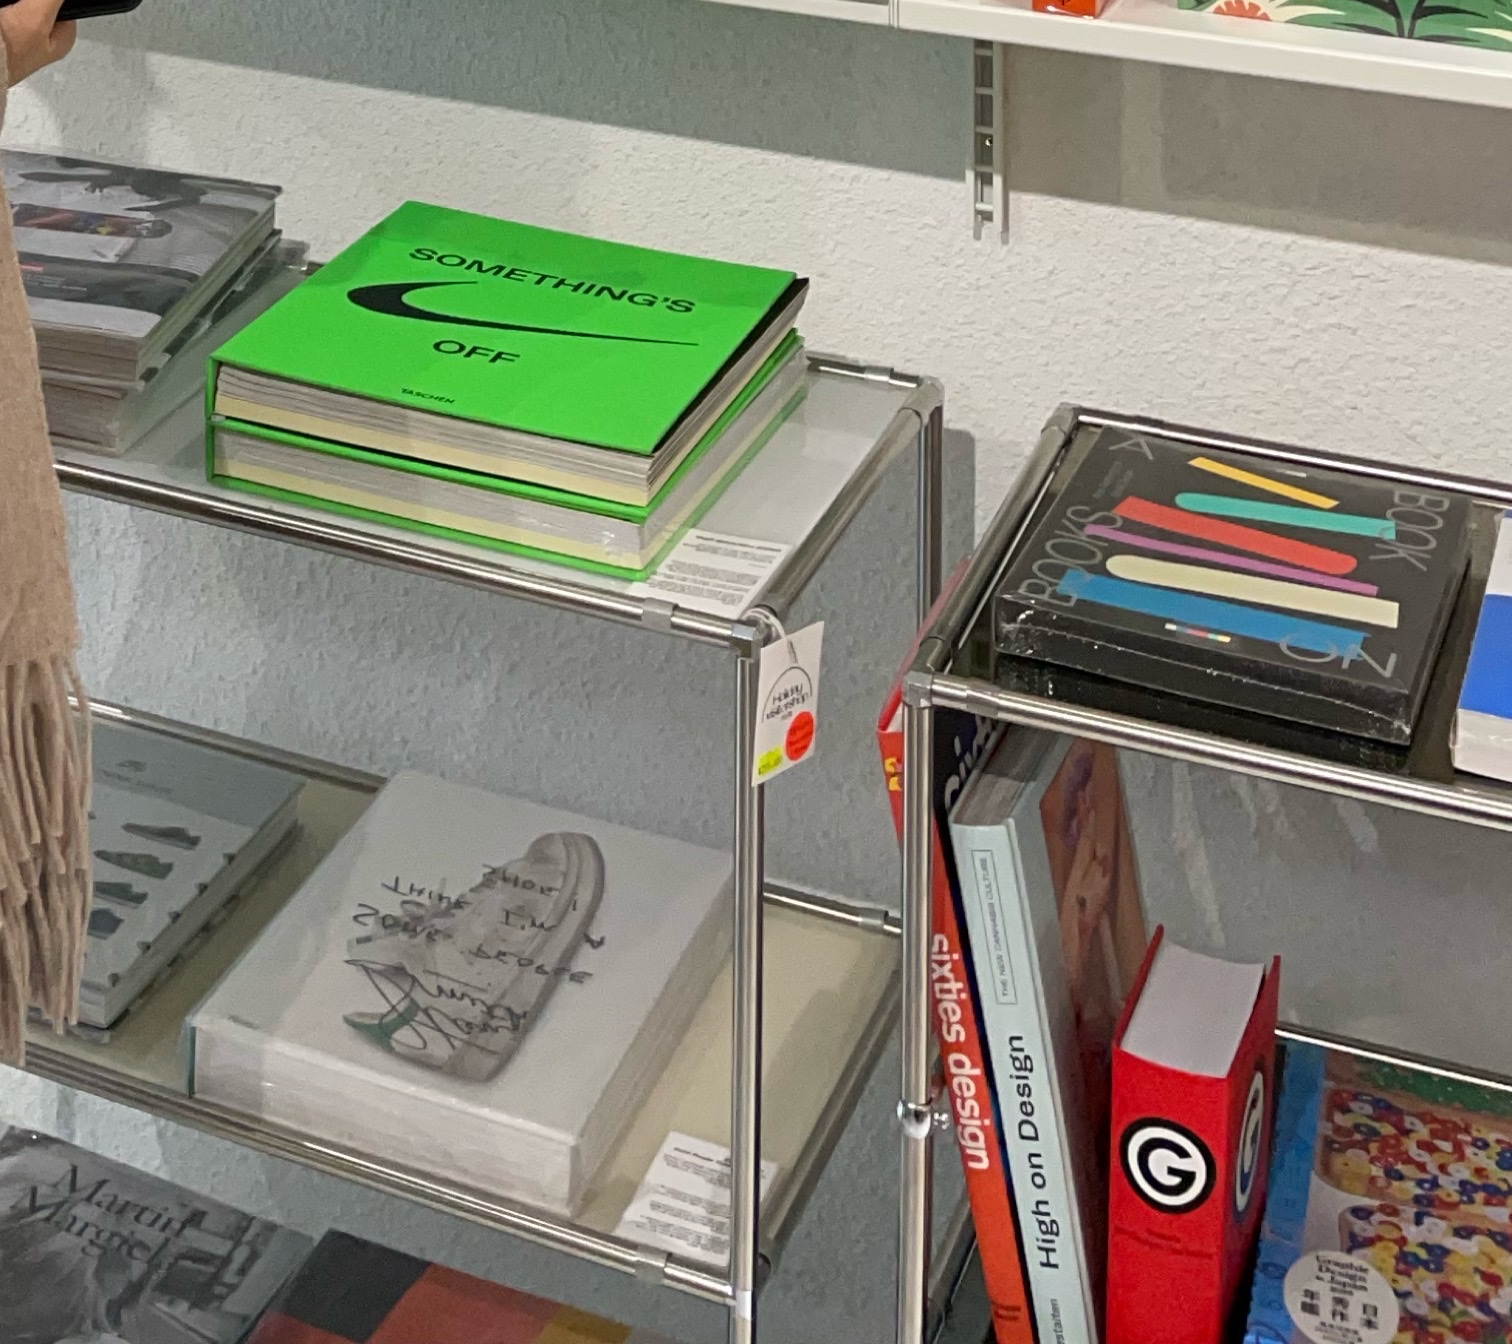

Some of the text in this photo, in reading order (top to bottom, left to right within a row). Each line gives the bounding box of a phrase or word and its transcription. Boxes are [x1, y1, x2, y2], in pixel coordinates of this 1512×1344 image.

[408, 248, 696, 313] SOMETHING'S
[433, 339, 520, 364] OFF
[401, 388, 455, 404] TASCHEN
[1019, 503, 1124, 608] BOOKS
[1368, 489, 1452, 573] BOOK
[930, 933, 992, 1171] sixties design
[1007, 1035, 1060, 1270] High on Design
